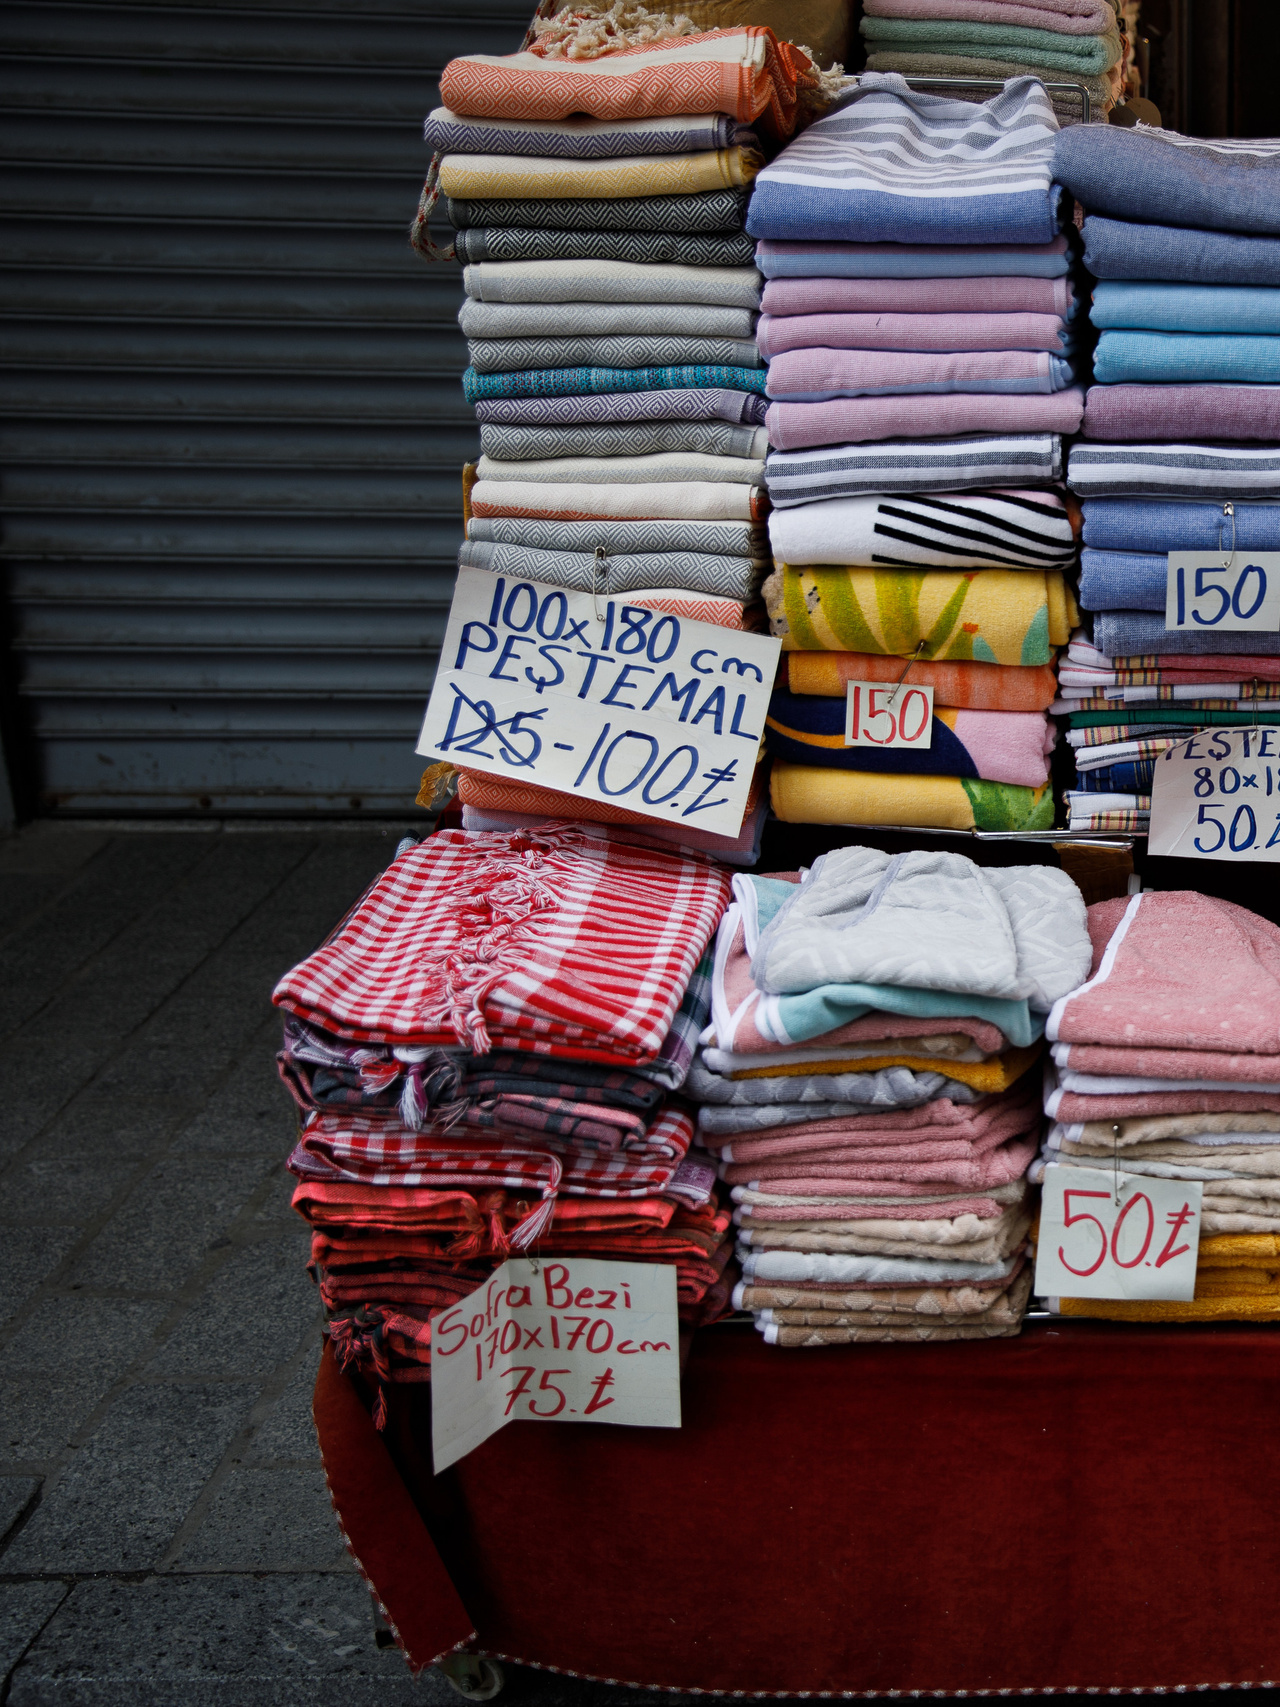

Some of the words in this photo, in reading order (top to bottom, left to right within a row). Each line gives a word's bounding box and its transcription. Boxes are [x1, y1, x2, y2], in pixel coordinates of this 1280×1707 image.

[1177, 564, 1267, 626] 150
[454, 620, 759, 741] PEŞTEMAL
[690, 649, 763, 683] cm
[852, 686, 929, 744] 150
[437, 1280, 533, 1356] Sofra
[543, 1264, 632, 1309] Bezi
